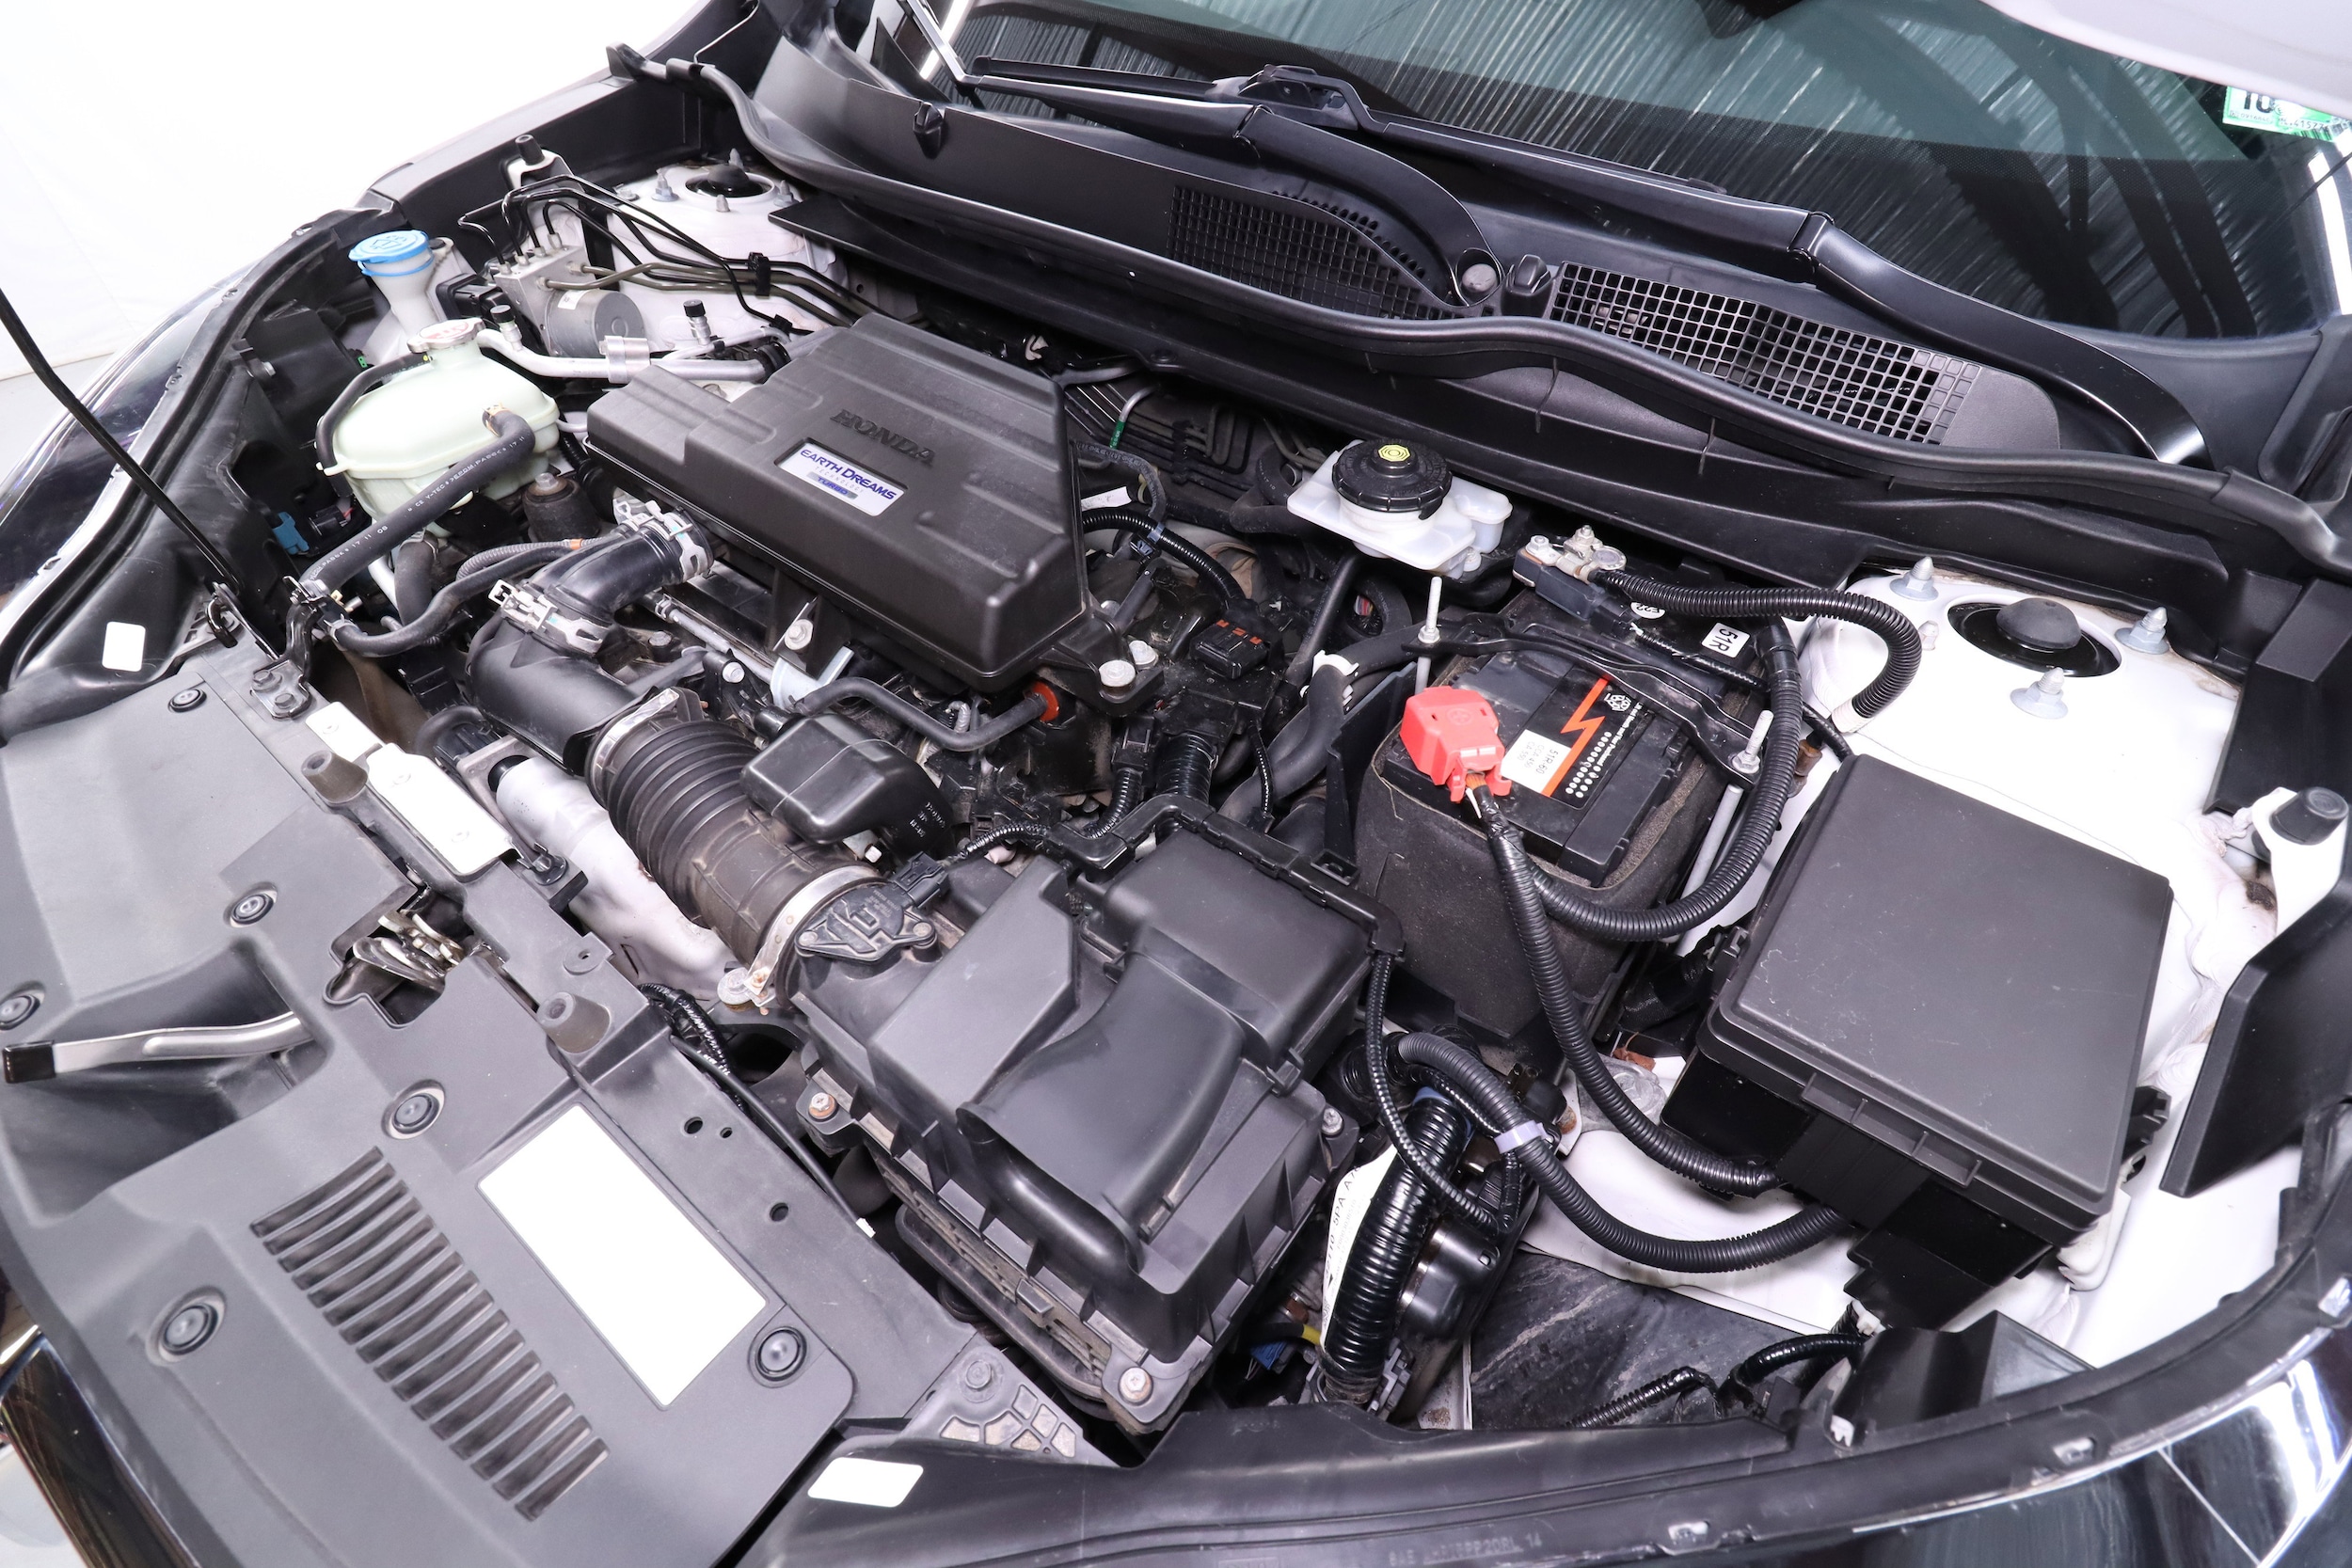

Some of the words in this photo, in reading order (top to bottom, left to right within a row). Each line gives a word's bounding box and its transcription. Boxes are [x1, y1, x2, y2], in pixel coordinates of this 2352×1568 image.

[830, 409, 934, 467] HONDA
[800, 449, 843, 473] EARTH
[841, 467, 898, 499] DREAMS
[815, 466, 865, 494] TECHNOLOGY
[818, 476, 849, 496] TURBO
[1708, 627, 1739, 652] 51R
